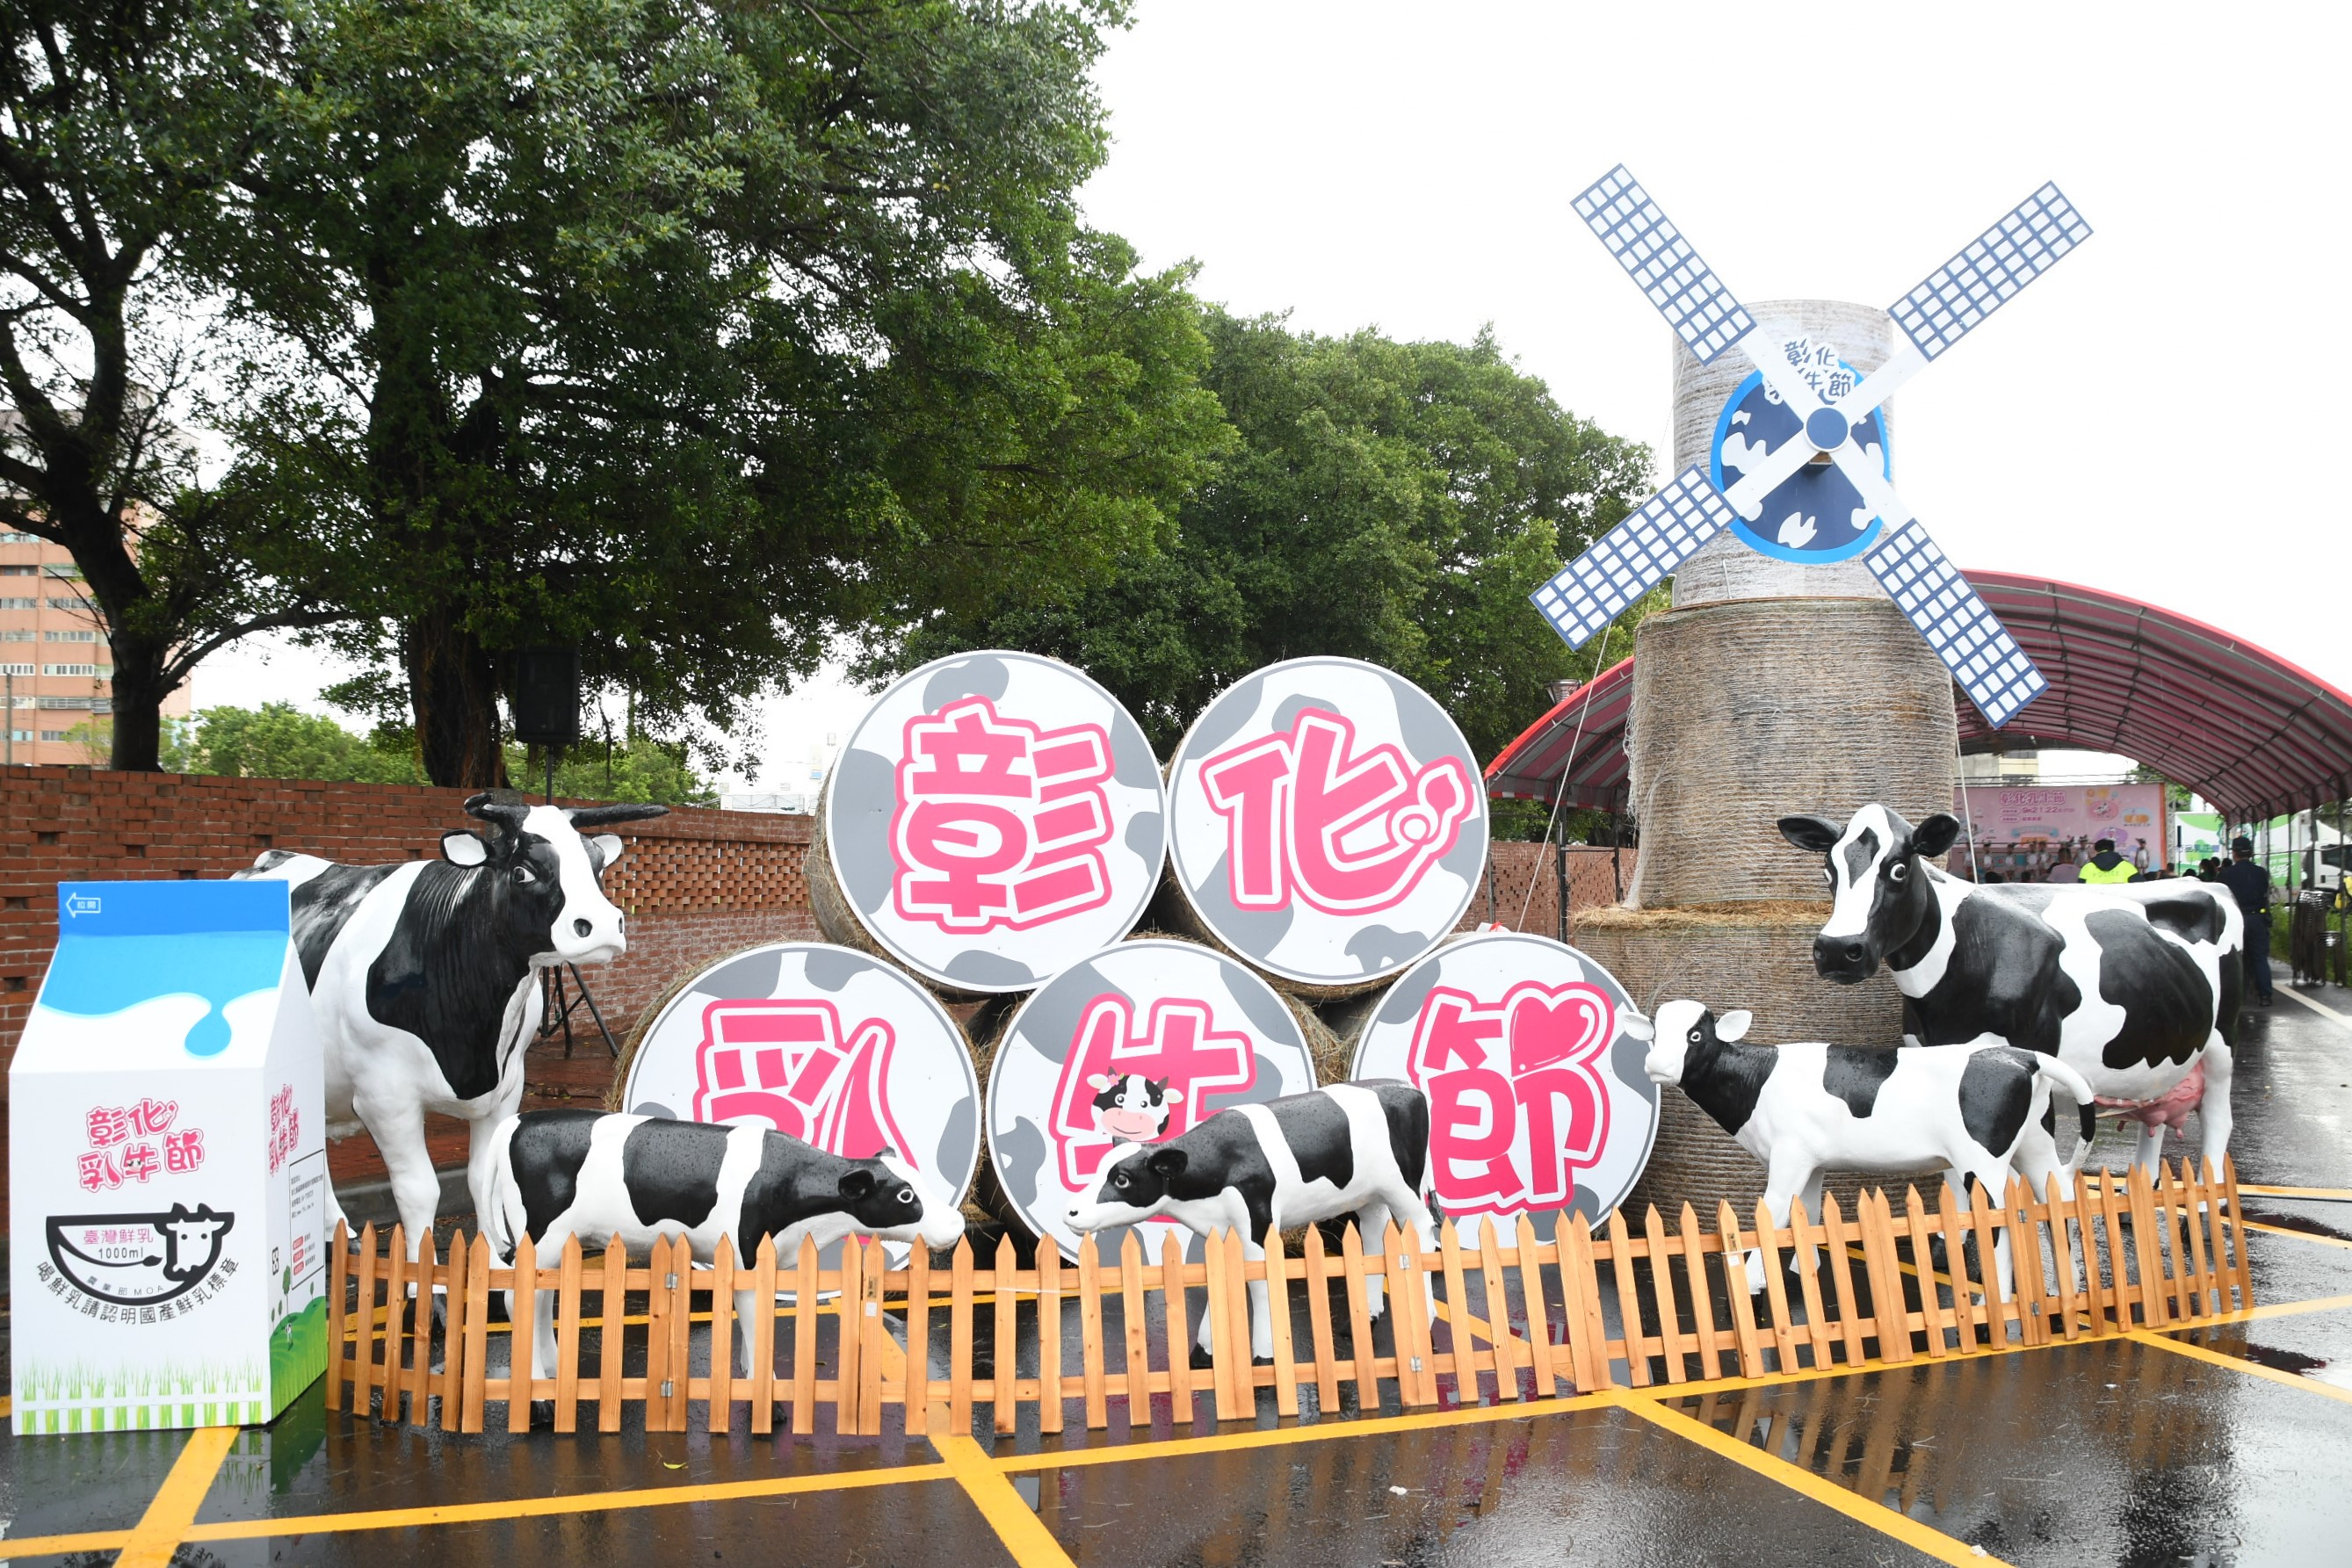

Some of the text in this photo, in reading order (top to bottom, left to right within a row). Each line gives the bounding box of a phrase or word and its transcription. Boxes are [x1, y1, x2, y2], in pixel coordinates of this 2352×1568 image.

[1784, 337, 1835, 366] 彰化
[86, 1098, 178, 1149] 彰化
[77, 1128, 205, 1193] 乳牛節
[83, 1228, 154, 1245] 臺灣鮮乳
[98, 1246, 143, 1259] 1000ml
[134, 1284, 164, 1296] MOA
